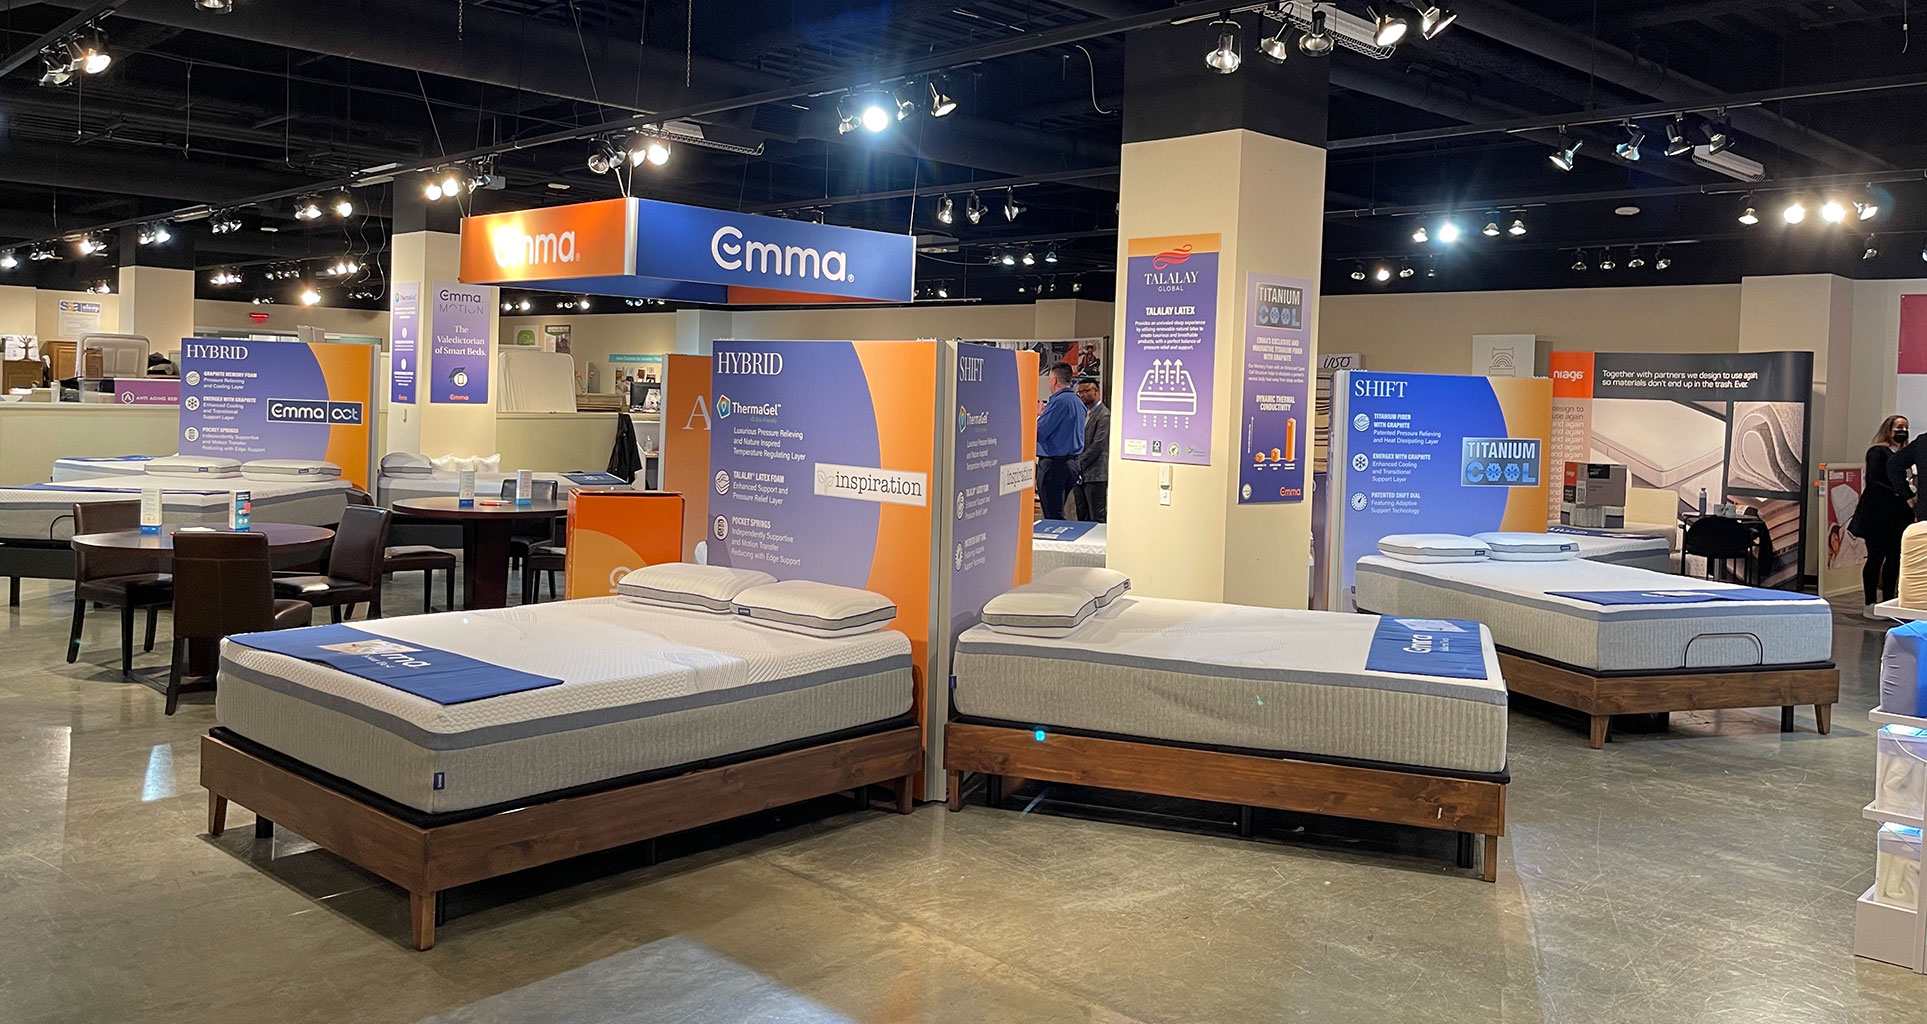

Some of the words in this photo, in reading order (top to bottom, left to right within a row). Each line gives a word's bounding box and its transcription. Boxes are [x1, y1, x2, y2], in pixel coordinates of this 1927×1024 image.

[1144, 271, 1199, 285] TALALAY
[1259, 287, 1300, 305] TITANIUM
[439, 304, 484, 315] MOTION
[1145, 306, 1173, 316] TALALAY
[1174, 306, 1196, 315] LATEX
[1258, 304, 1300, 327] COOL
[454, 325, 469, 334] The
[437, 335, 485, 345] Valedictorian
[186, 344, 249, 360] HYBRID
[435, 347, 444, 355] of
[444, 347, 466, 355] Smart
[467, 348, 486, 356] Beds.
[717, 352, 783, 376] HYBRID
[959, 356, 984, 382] SHIFT
[1602, 369, 1635, 379] Together
[1636, 370, 1652, 378] with
[1654, 371, 1686, 380] partners
[1699, 372, 1722, 381] design
[1722, 372, 1730, 380] to
[1354, 379, 1408, 398] SHIFT
[1612, 378, 1646, 387] materials
[1648, 378, 1667, 387] don't
[1668, 380, 1682, 388] end
[1682, 380, 1692, 389] up
[1694, 380, 1700, 388] in
[1702, 380, 1714, 388] the
[1714, 380, 1734, 388] trash.
[734, 427, 757, 437] Luxurious
[758, 428, 779, 438] Pressure
[780, 430, 804, 440] Relieving
[734, 438, 743, 446] and
[744, 438, 760, 447] Nature
[760, 440, 781, 449] Inspired
[1396, 438, 1424, 446] Dissipating
[1425, 438, 1440, 446] Layer
[734, 447, 763, 458] Temperature
[764, 450, 790, 460] Regulating
[791, 452, 806, 462] Layer
[1466, 441, 1535, 460] TITANIUM
[756, 472, 770, 482] LATEX
[770, 474, 784, 484] FOAM
[1465, 462, 1536, 483] COOL
[835, 471, 922, 497] inspiration
[1372, 476, 1392, 484] Support
[733, 481, 756, 492] Enhanced
[758, 483, 778, 494] Support
[778, 487, 789, 495] and
[733, 492, 754, 501] Pressure
[754, 494, 768, 503] Relief
[768, 496, 784, 506] Layer
[1410, 492, 1421, 500] DIAL
[1371, 500, 1394, 508] Featuring
[1396, 500, 1418, 508] Adaptive
[1392, 508, 1420, 516] Technology
[732, 516, 750, 526] POCKET
[750, 518, 771, 529] SPRINGS
[732, 528, 766, 540] Independently
[766, 532, 794, 544] Supportive
[741, 540, 759, 549] Motion
[760, 542, 779, 552] Transfer
[731, 548, 754, 560] Reducing
[754, 552, 766, 560] with
[766, 554, 779, 564] Edge
[780, 556, 800, 566] Support
